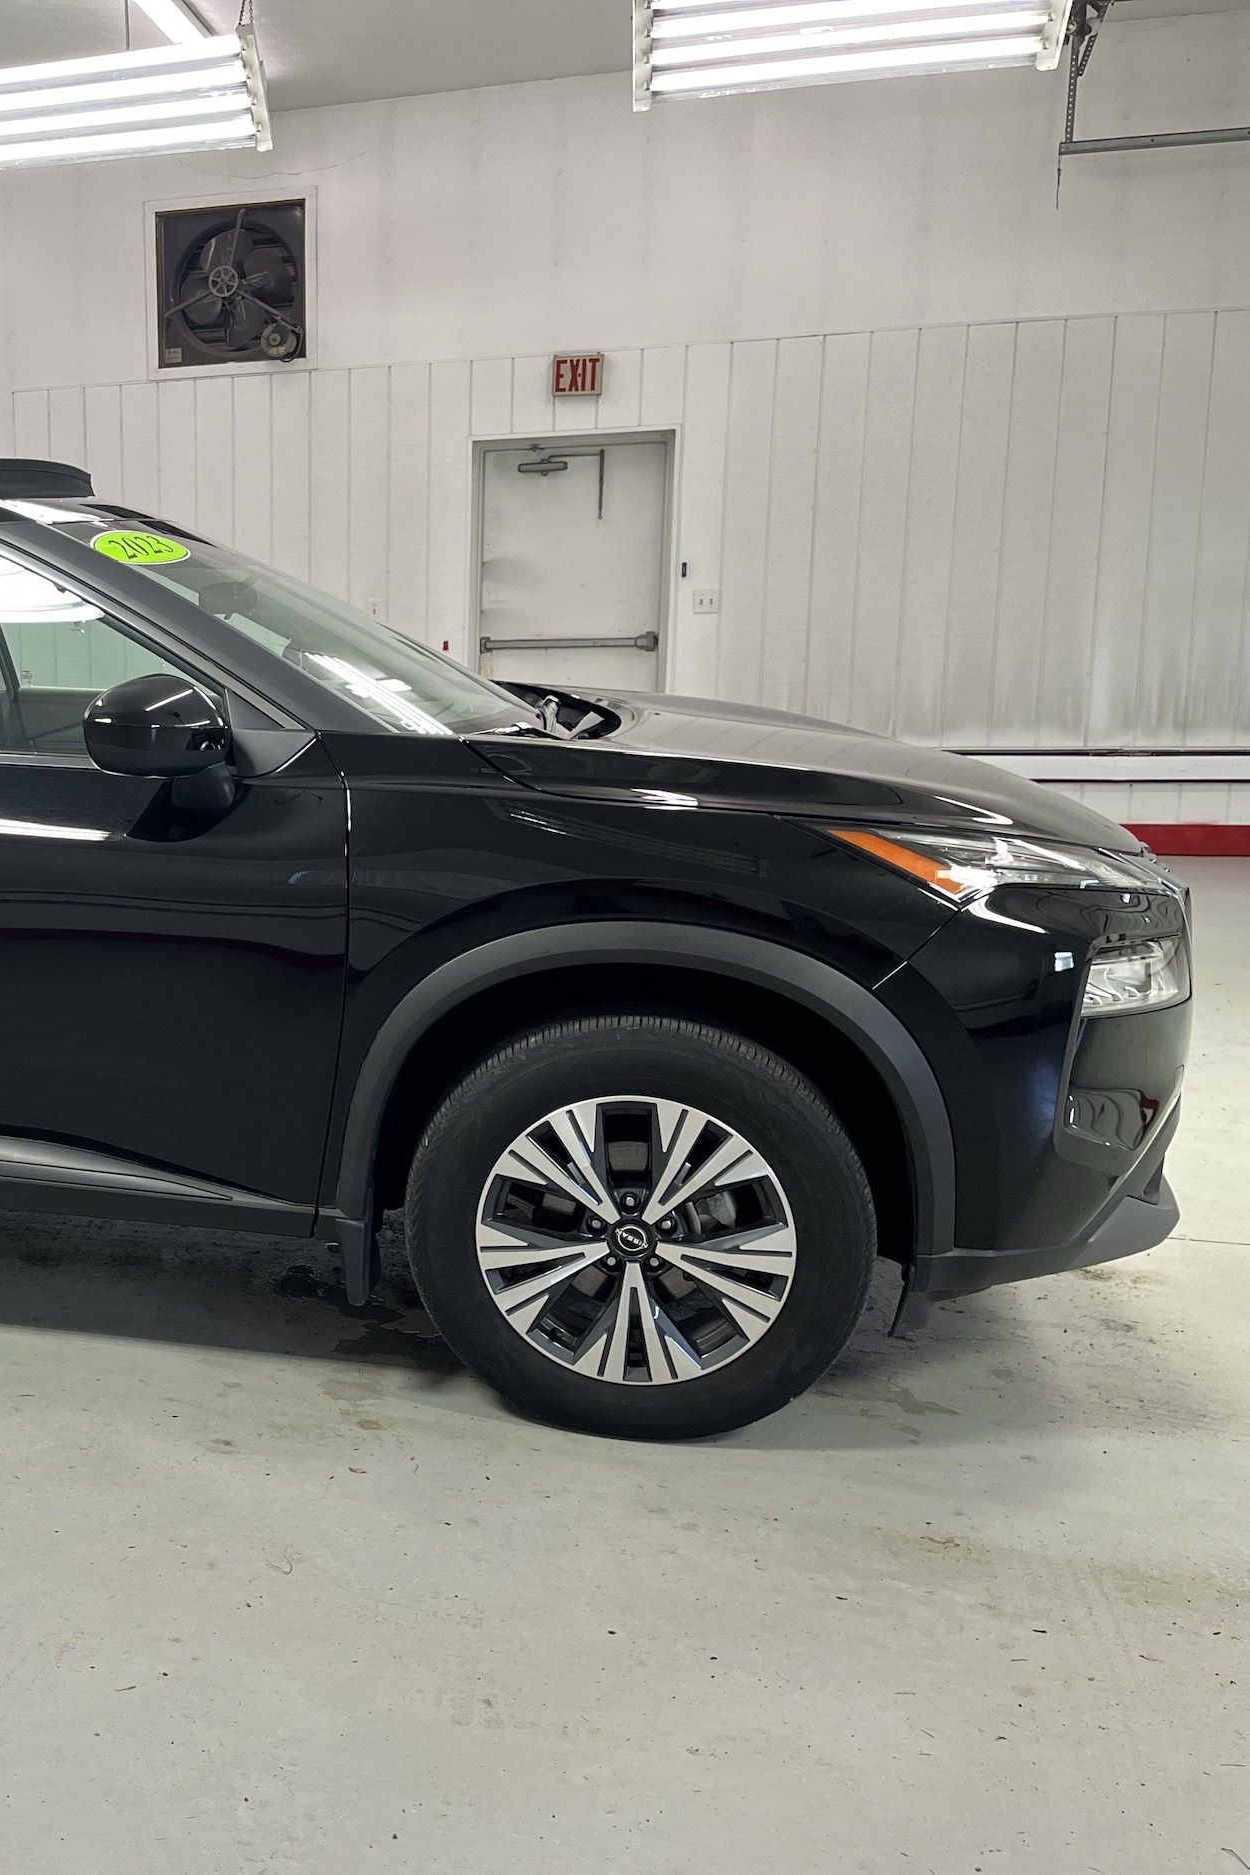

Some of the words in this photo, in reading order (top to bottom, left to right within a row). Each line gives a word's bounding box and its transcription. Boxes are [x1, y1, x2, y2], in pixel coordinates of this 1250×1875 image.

[555, 358, 600, 392] EXIT
[108, 535, 174, 559] 2023
[615, 1228, 649, 1249] NISSAN
